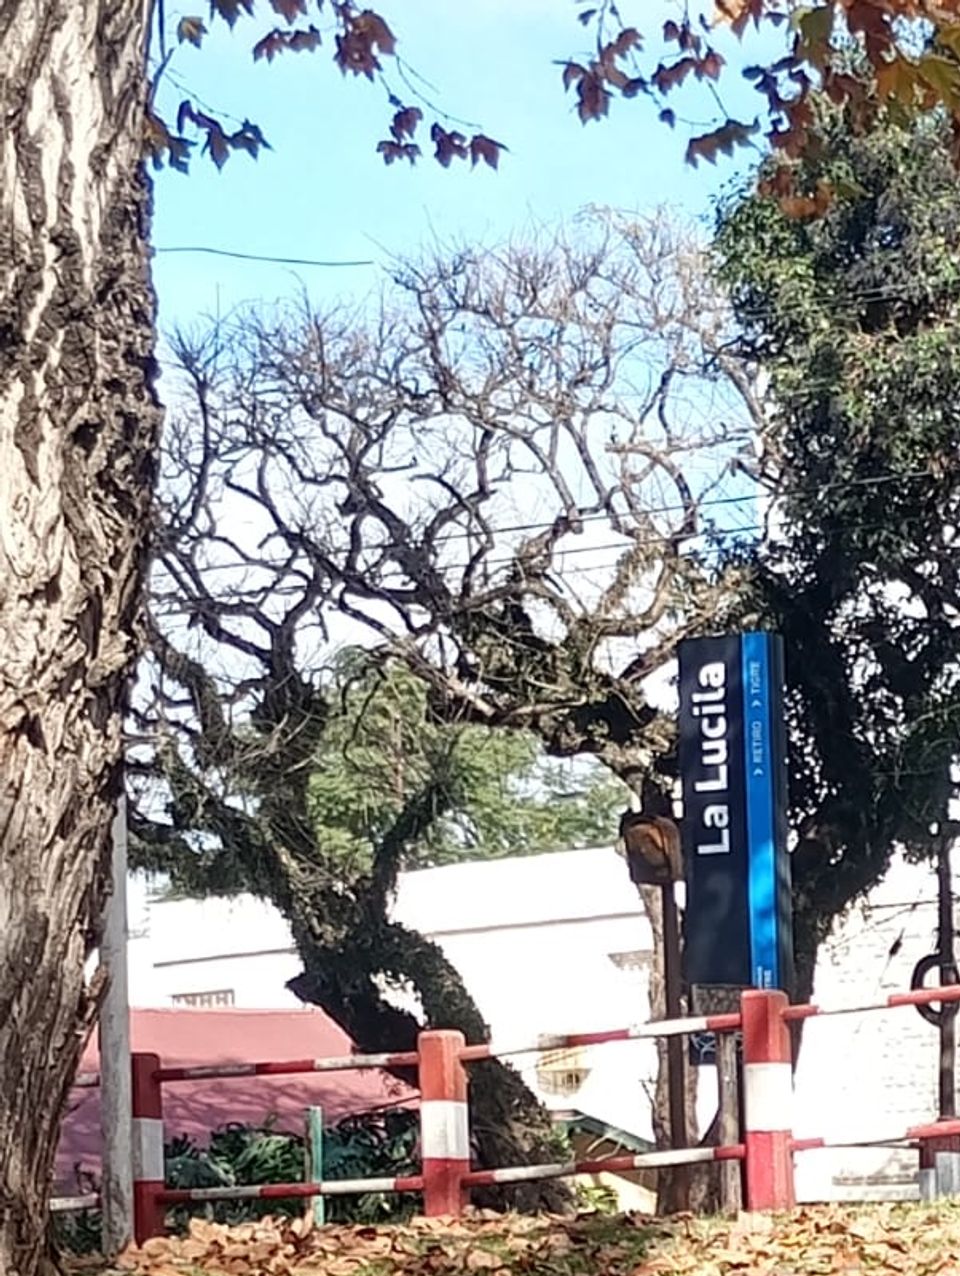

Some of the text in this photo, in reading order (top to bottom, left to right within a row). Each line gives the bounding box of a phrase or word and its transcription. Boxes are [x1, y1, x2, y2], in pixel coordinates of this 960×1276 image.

[692, 661, 731, 855] La Lucila
[749, 660, 763, 763] RETIRO TIGRE
